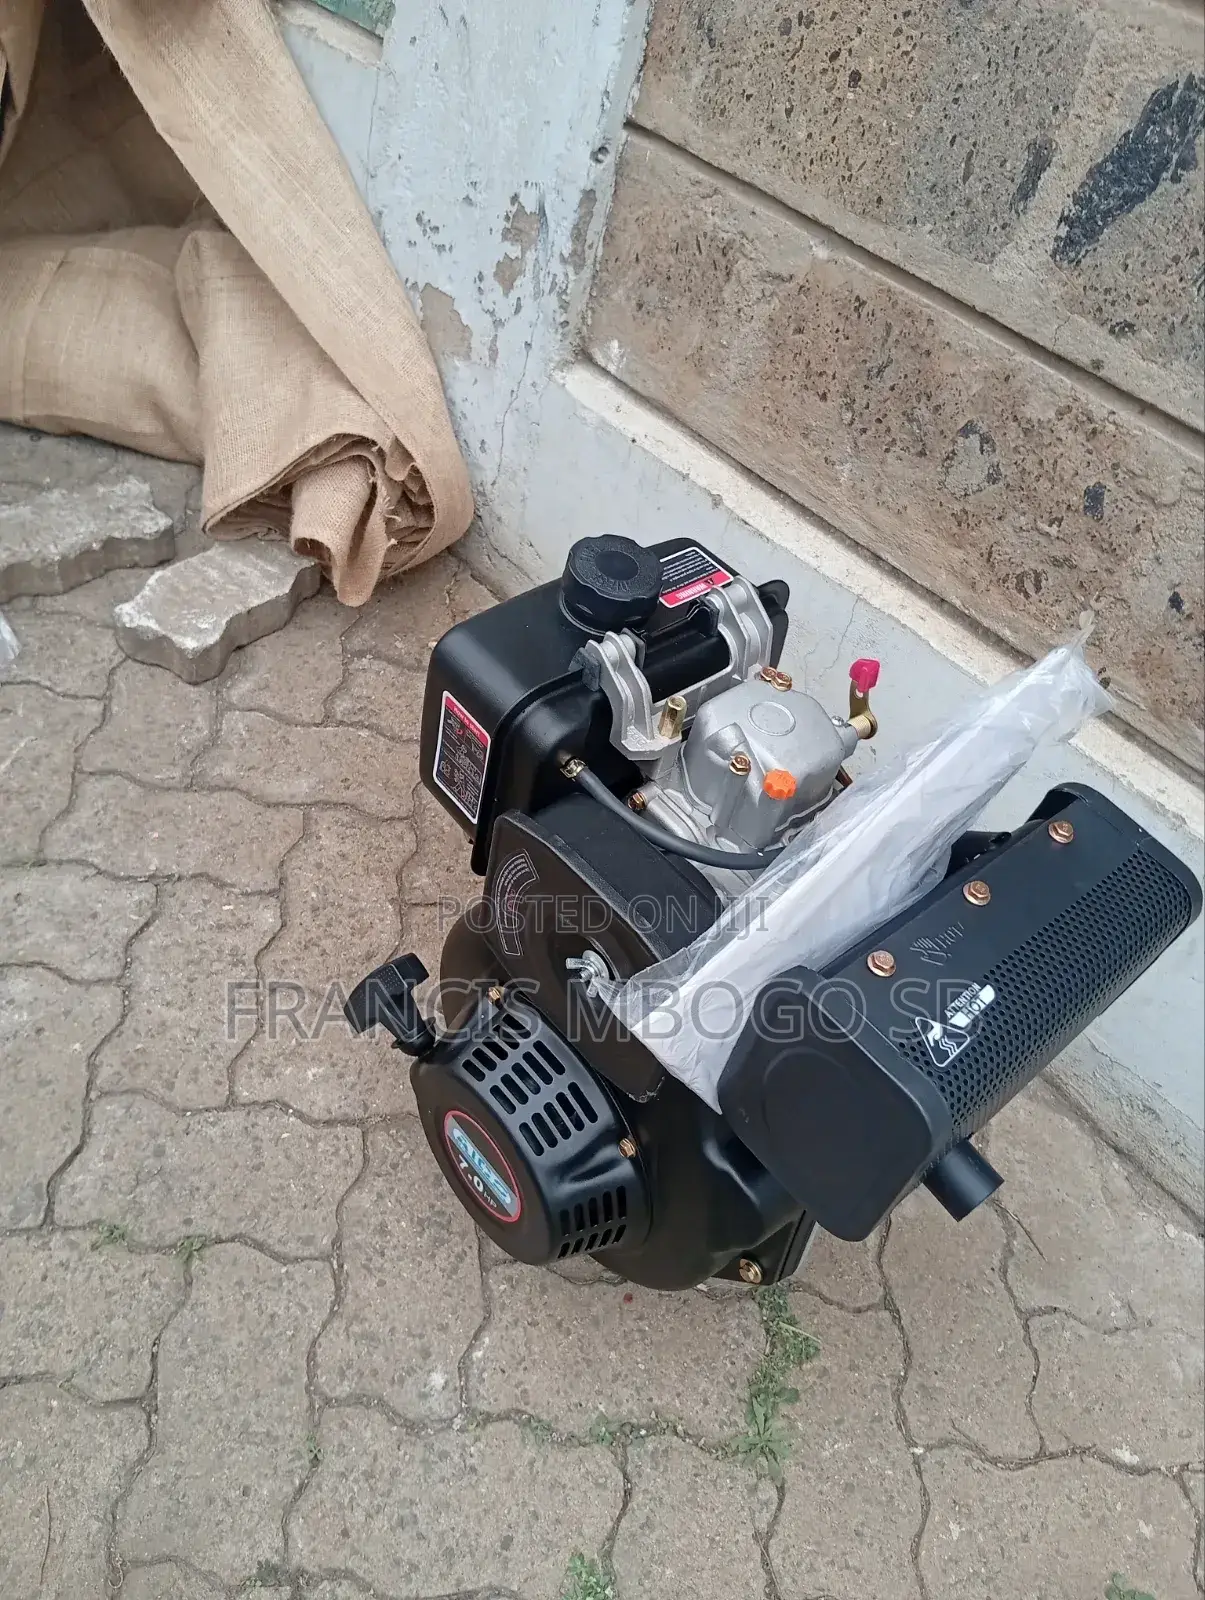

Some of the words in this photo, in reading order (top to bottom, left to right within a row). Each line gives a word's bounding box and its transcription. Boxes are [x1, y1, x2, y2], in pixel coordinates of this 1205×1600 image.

[675, 582, 708, 600] WARNING
[944, 982, 982, 1019] ATTENTION
[960, 996, 987, 1020] HOT
